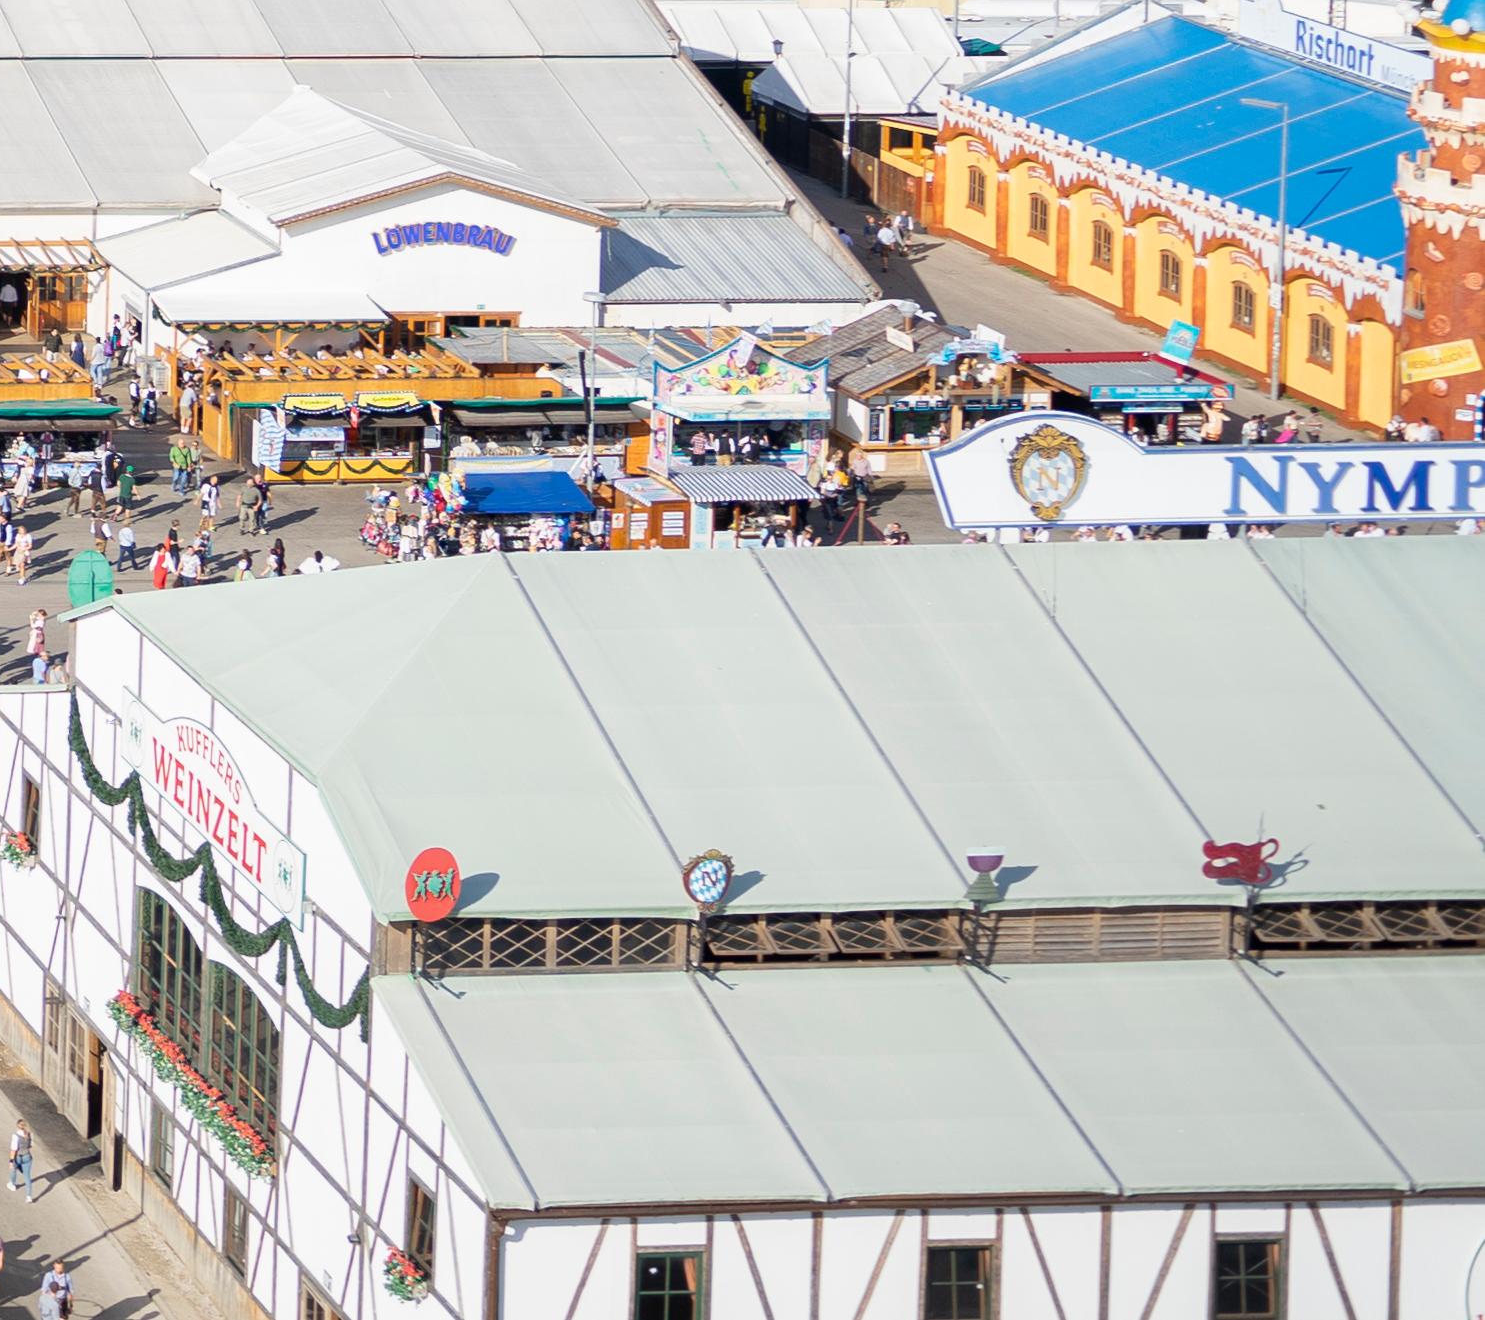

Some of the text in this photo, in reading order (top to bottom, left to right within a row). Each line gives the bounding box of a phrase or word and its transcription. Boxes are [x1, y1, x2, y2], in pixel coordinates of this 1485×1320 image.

[1295, 20, 1375, 77] Rischart
[372, 221, 517, 257] LÖWENBRÄU
[176, 724, 243, 805] KUFFLERS
[152, 736, 267, 886] WEINZELT
